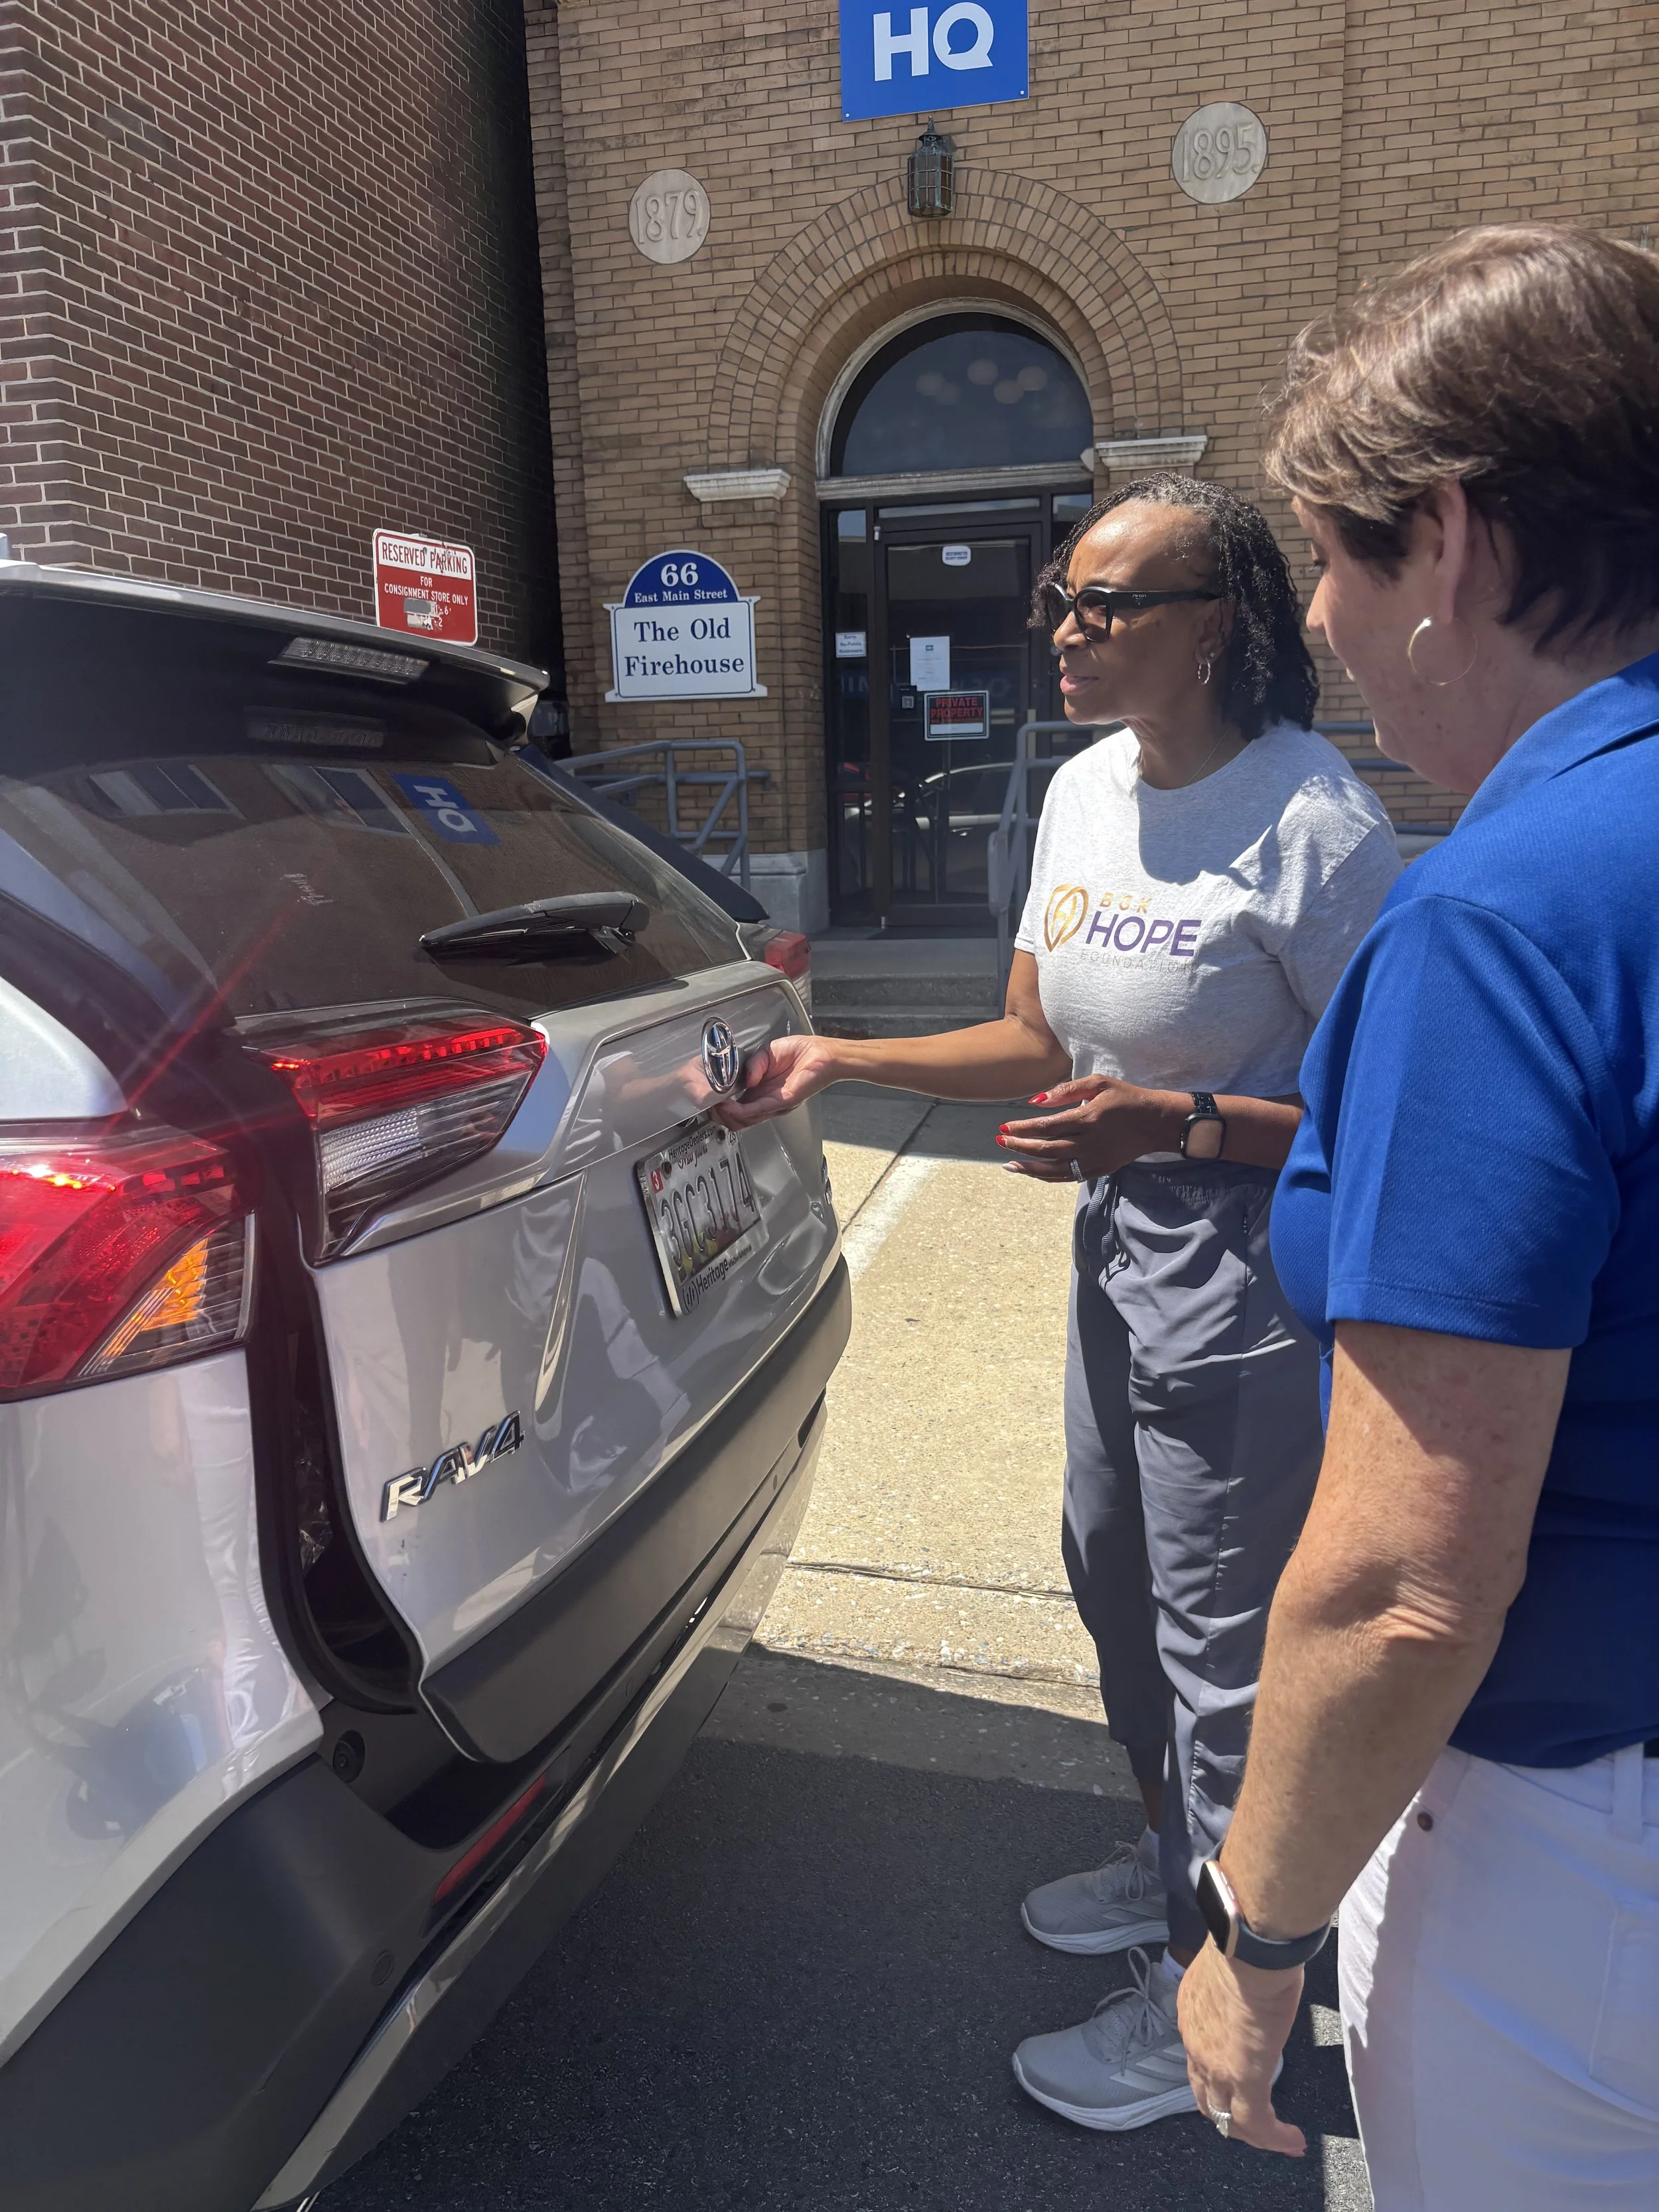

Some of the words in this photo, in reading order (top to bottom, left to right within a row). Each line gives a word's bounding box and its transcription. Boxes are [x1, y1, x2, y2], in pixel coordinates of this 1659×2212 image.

[873, 1, 994, 82] HQ
[382, 542, 425, 567] RESERVED
[431, 551, 468, 574] PARKING
[420, 576, 433, 587] FOR
[661, 562, 699, 587] 66
[384, 583, 429, 601] CONSIGNMENT
[431, 590, 451, 603] STORE
[452, 594, 469, 606] ONLY
[634, 592, 658, 603] East
[662, 590, 690, 601] Main
[694, 589, 728, 600] Street
[634, 621, 680, 642] The
[690, 617, 731, 640] Old
[624, 654, 745, 677] Firehouse
[930, 707, 983, 718] PROPERTY
[935, 698, 978, 707] PRIVATE
[1085, 911, 1202, 957] HOPE
[652, 1171, 660, 1191] 3
[660, 1152, 755, 1272] 3GC3174
[696, 1258, 729, 1295] Heritage
[380, 1410, 526, 1522] RAV4
